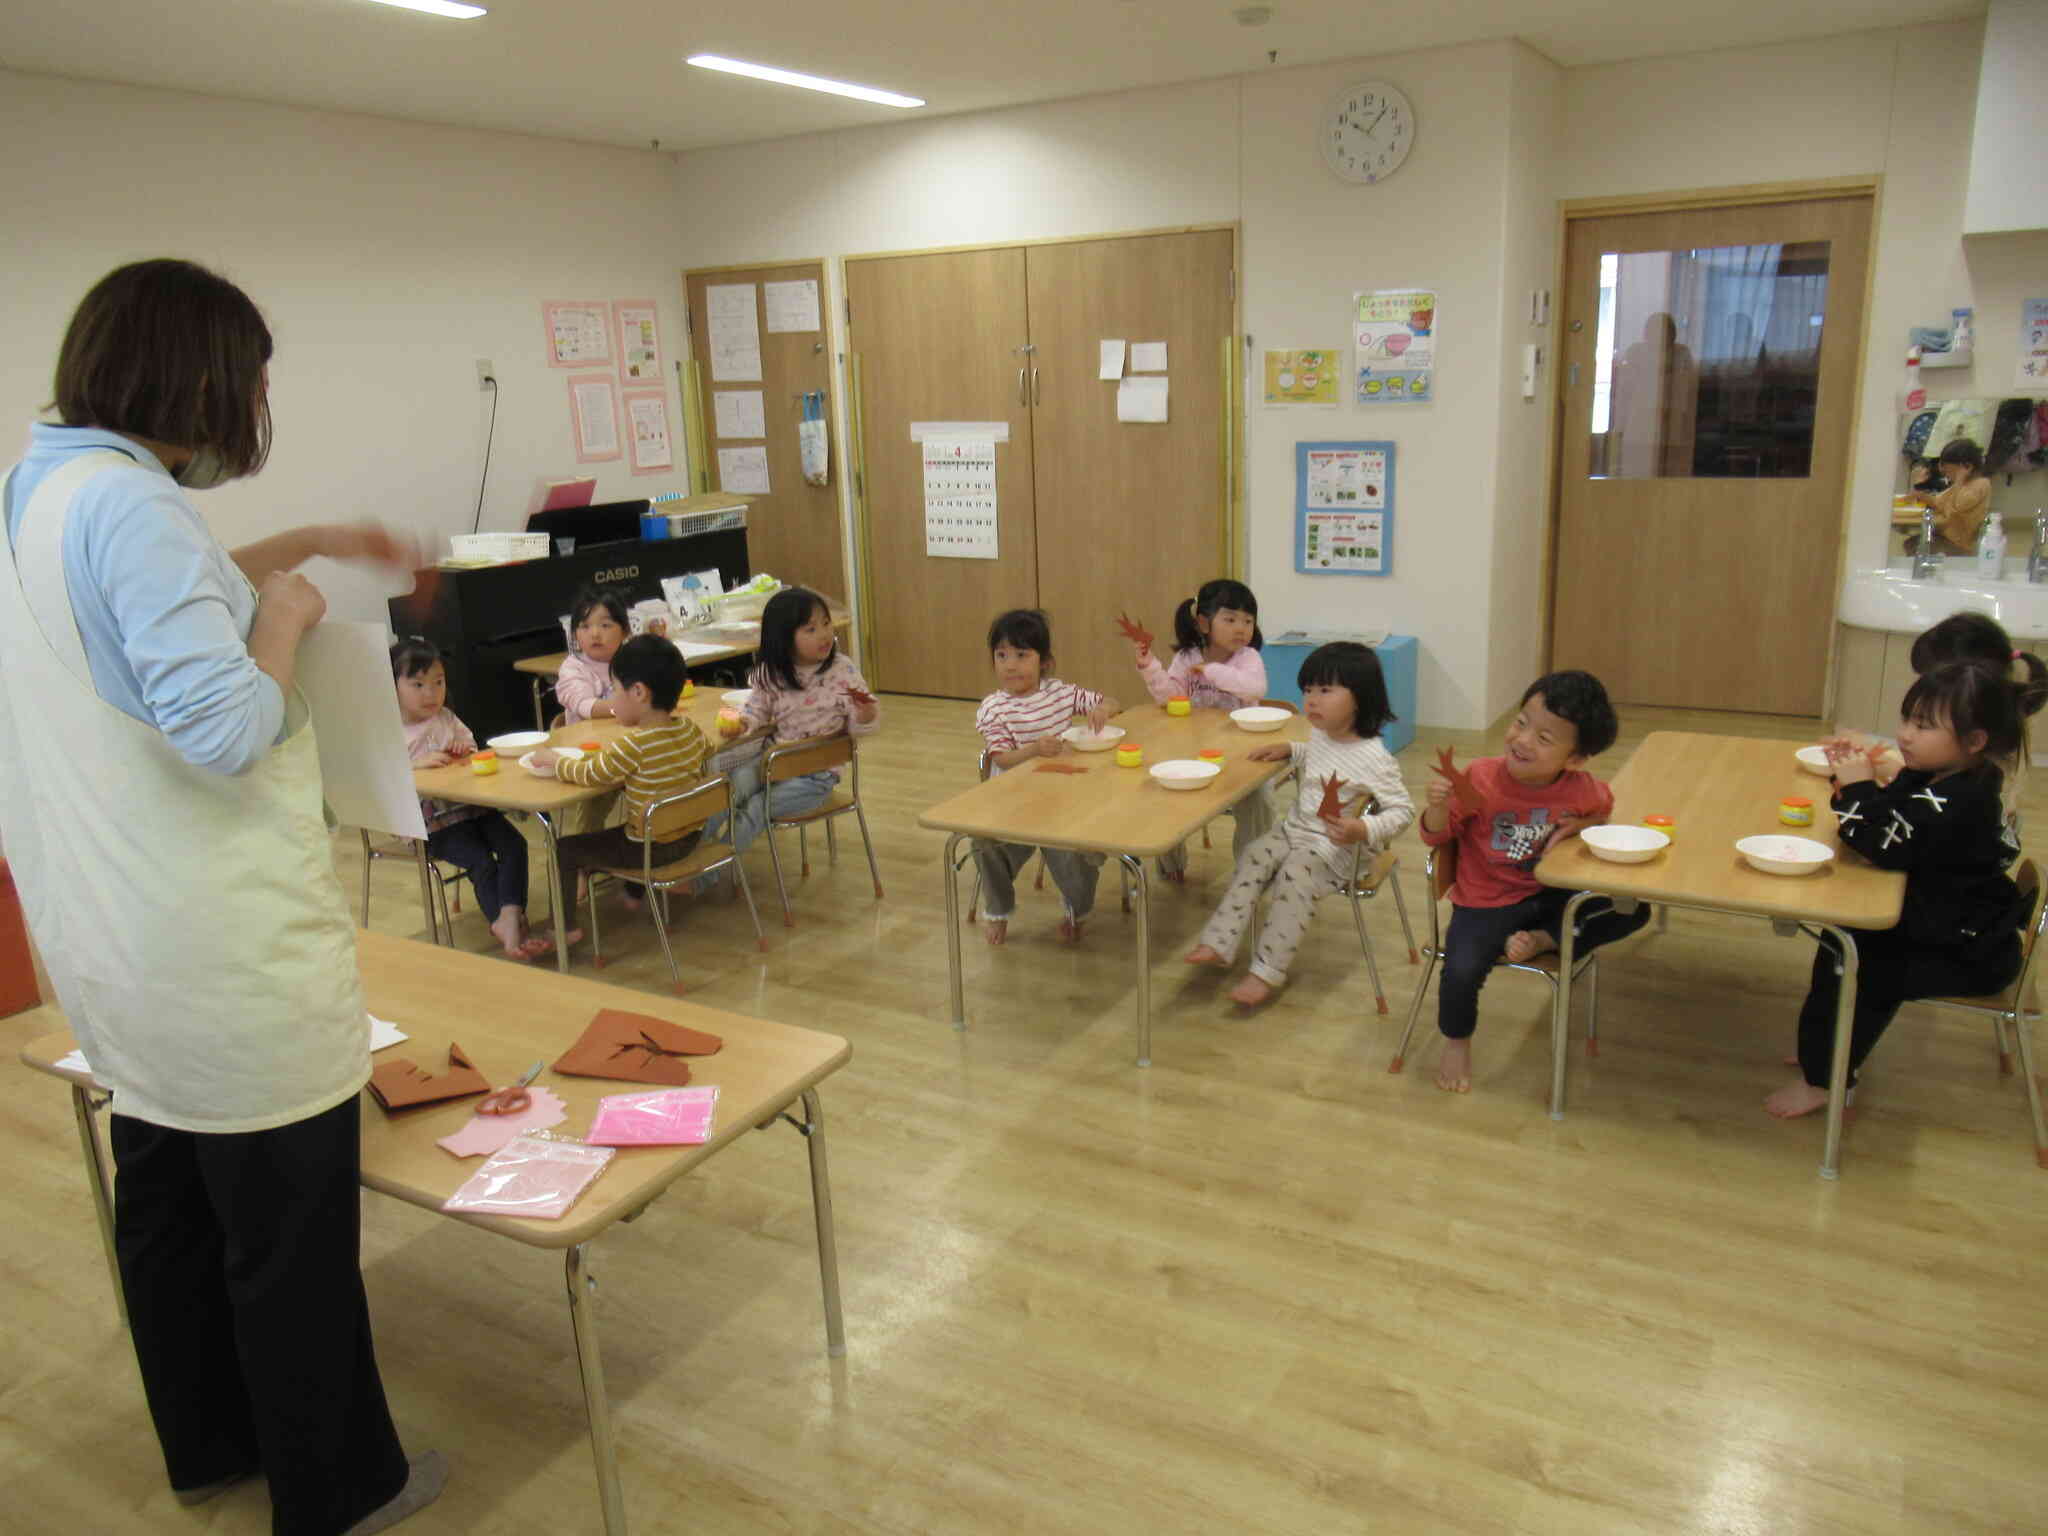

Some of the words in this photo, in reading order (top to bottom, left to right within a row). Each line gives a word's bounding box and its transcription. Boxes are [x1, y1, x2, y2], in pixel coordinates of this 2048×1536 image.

[1349, 100, 1357, 113] 11
[1363, 93, 1374, 107] 12
[595, 565, 640, 583] CASIO
